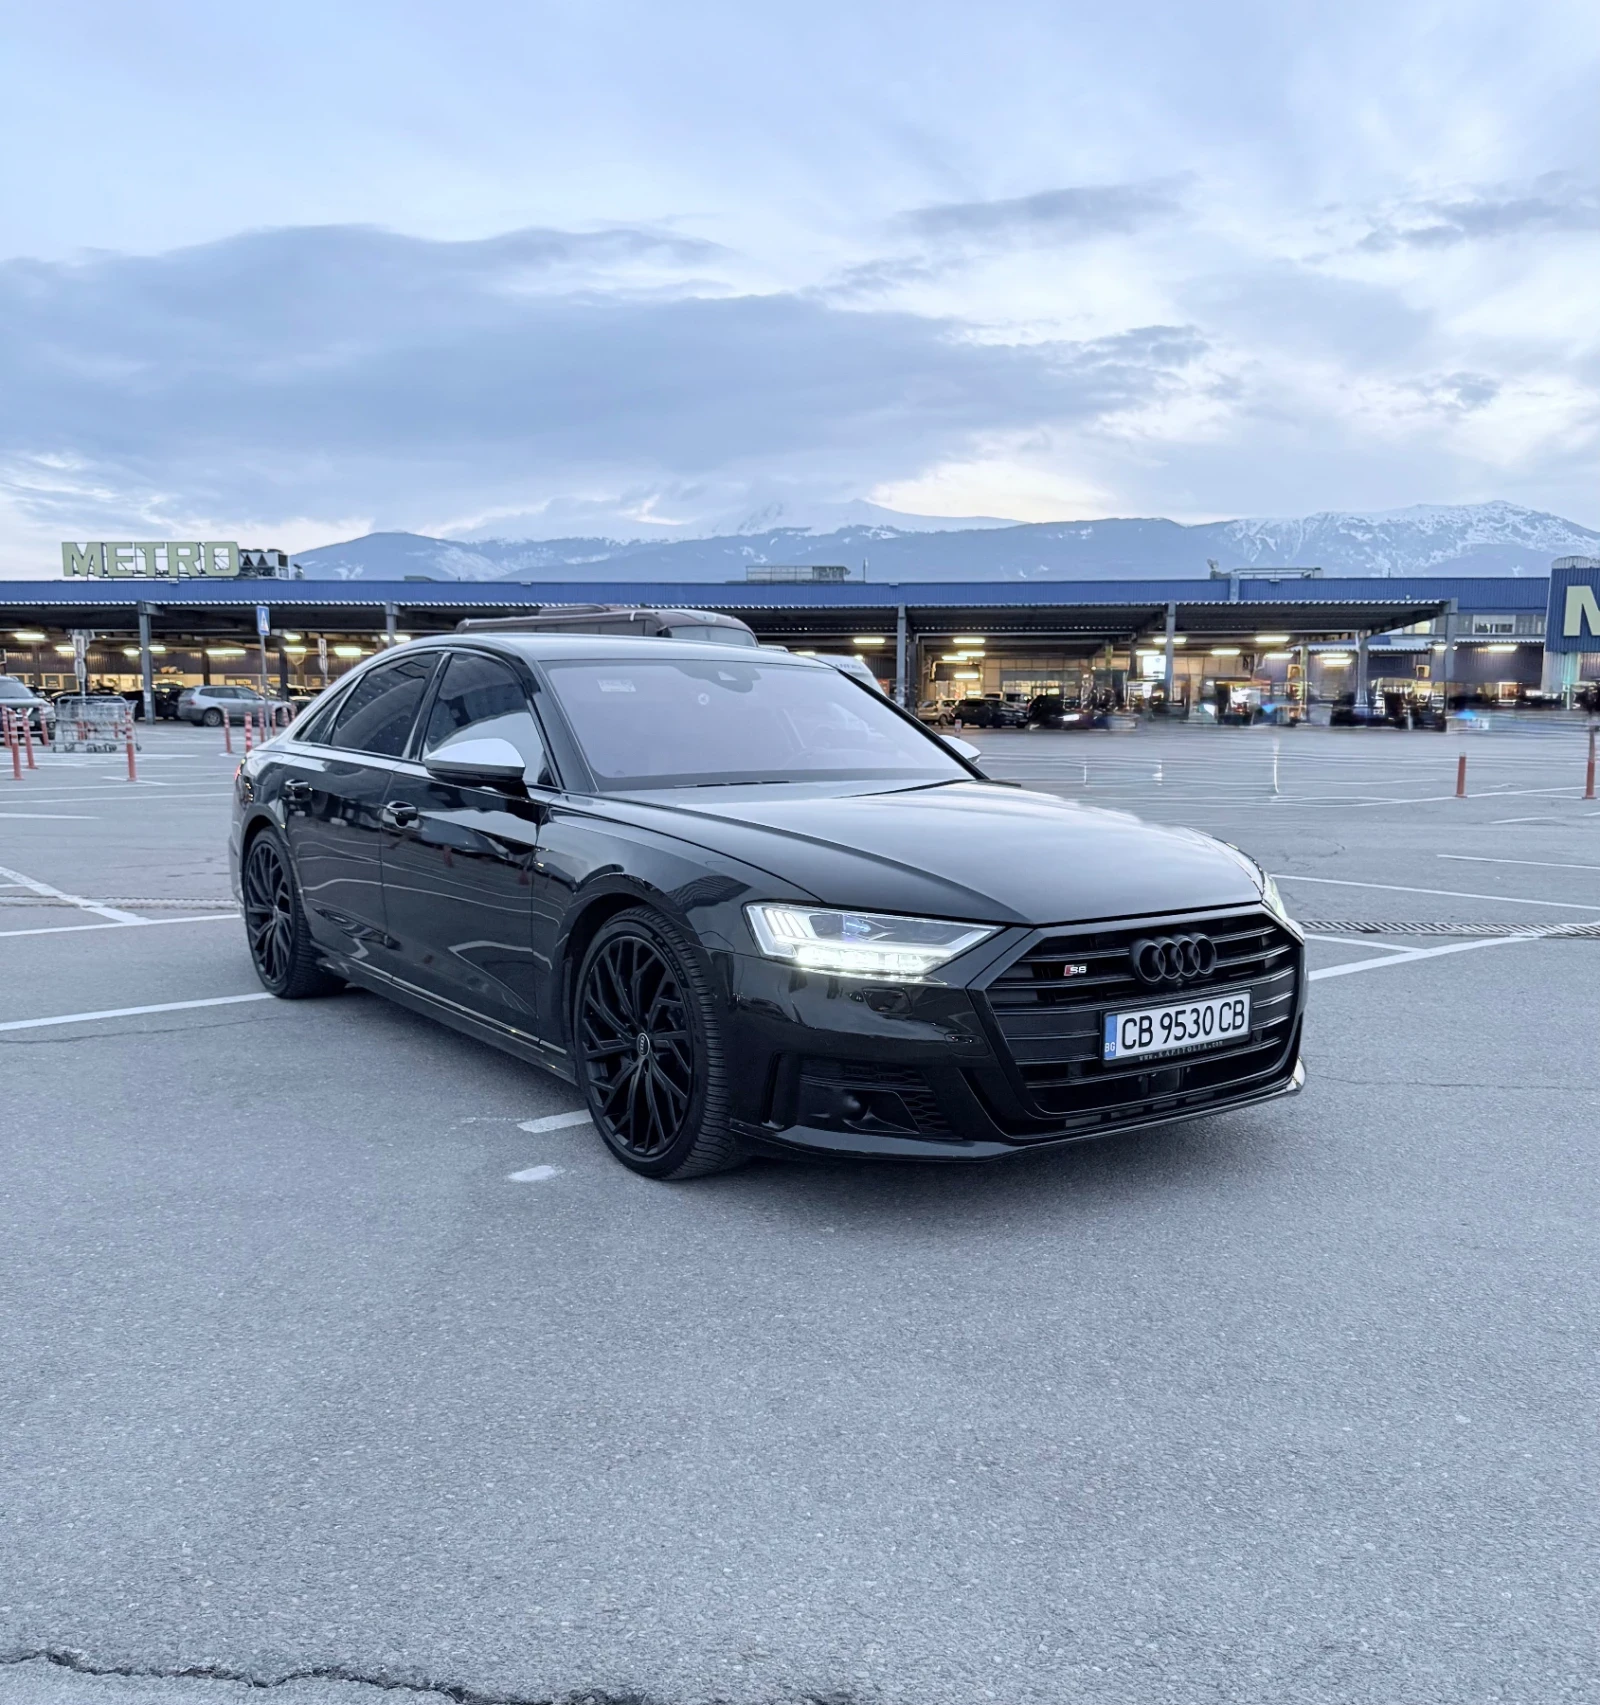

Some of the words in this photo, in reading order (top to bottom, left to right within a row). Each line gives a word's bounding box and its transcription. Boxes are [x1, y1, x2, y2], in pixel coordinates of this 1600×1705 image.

[62, 541, 240, 577] METRO
[1122, 1015, 1153, 1050] CB
[1159, 1005, 1214, 1044] 9530
[1219, 999, 1245, 1033] CB
[1104, 1041, 1115, 1053] BG
